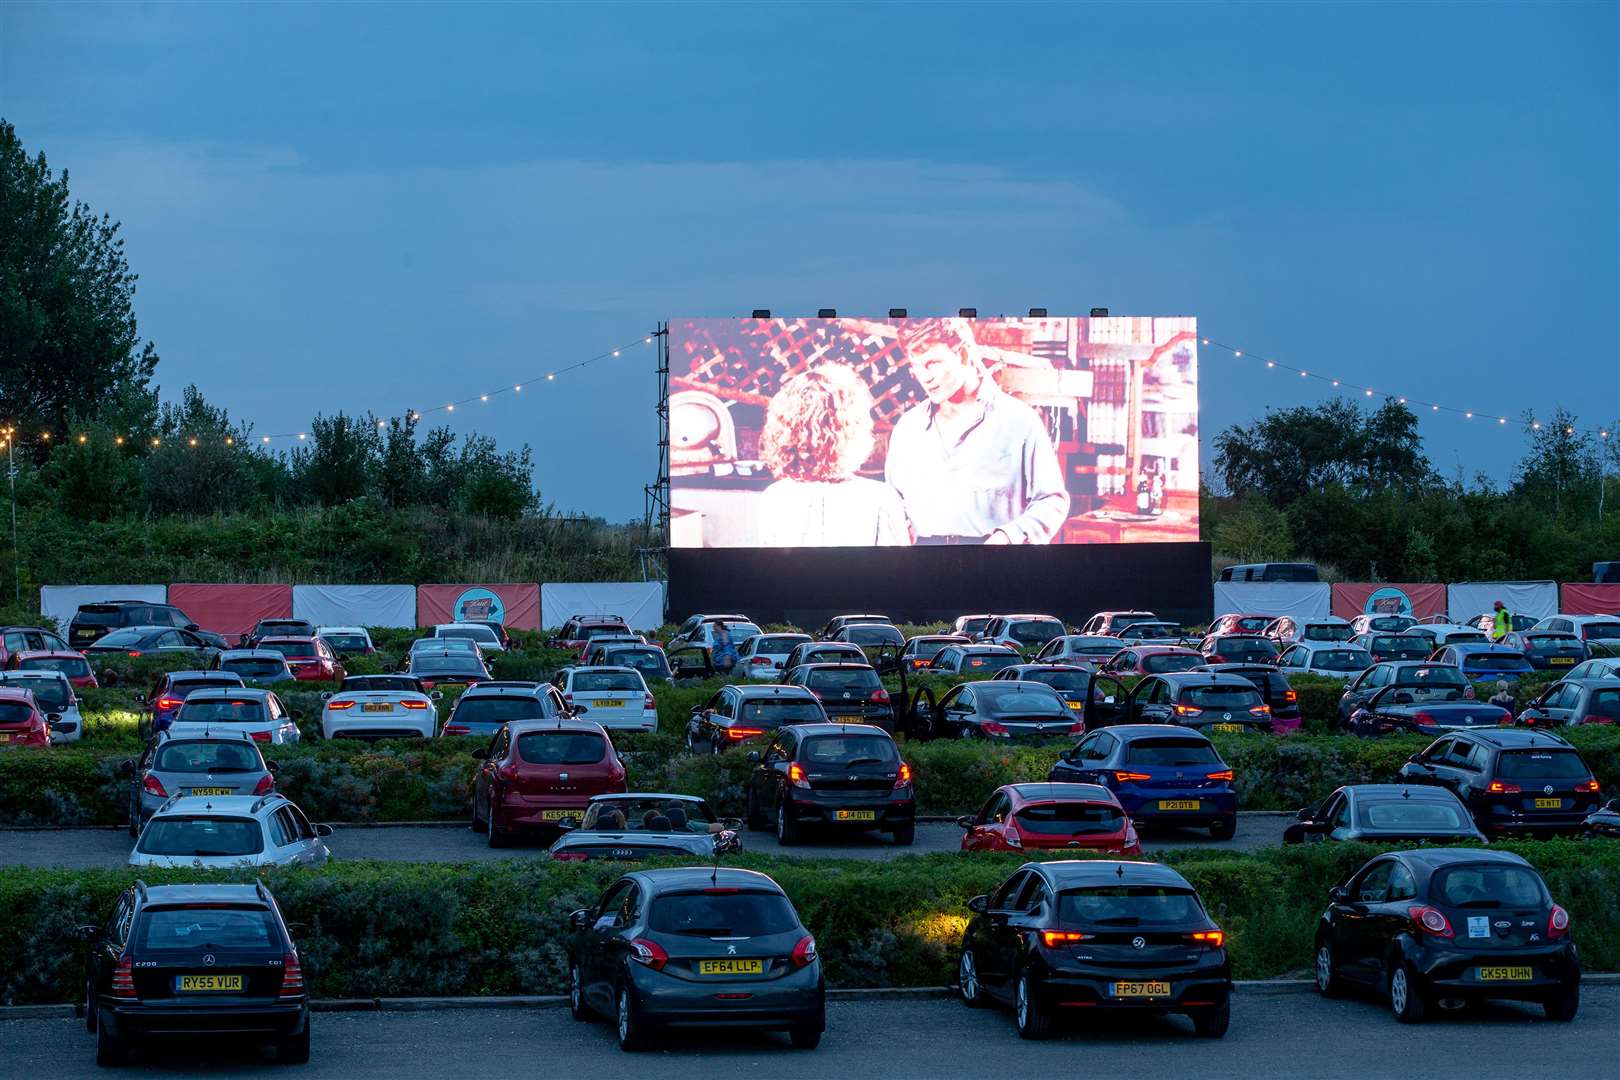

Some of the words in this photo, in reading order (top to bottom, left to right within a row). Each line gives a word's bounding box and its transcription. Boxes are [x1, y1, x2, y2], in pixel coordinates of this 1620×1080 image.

[704, 961, 733, 972] EF64
[736, 961, 758, 972] LLP
[1480, 968, 1508, 979] GK59
[1510, 967, 1531, 979] UHN
[184, 977, 214, 988] RY55
[217, 977, 240, 988] VUR
[1116, 983, 1144, 994] FP67
[1147, 983, 1169, 994] OGL
